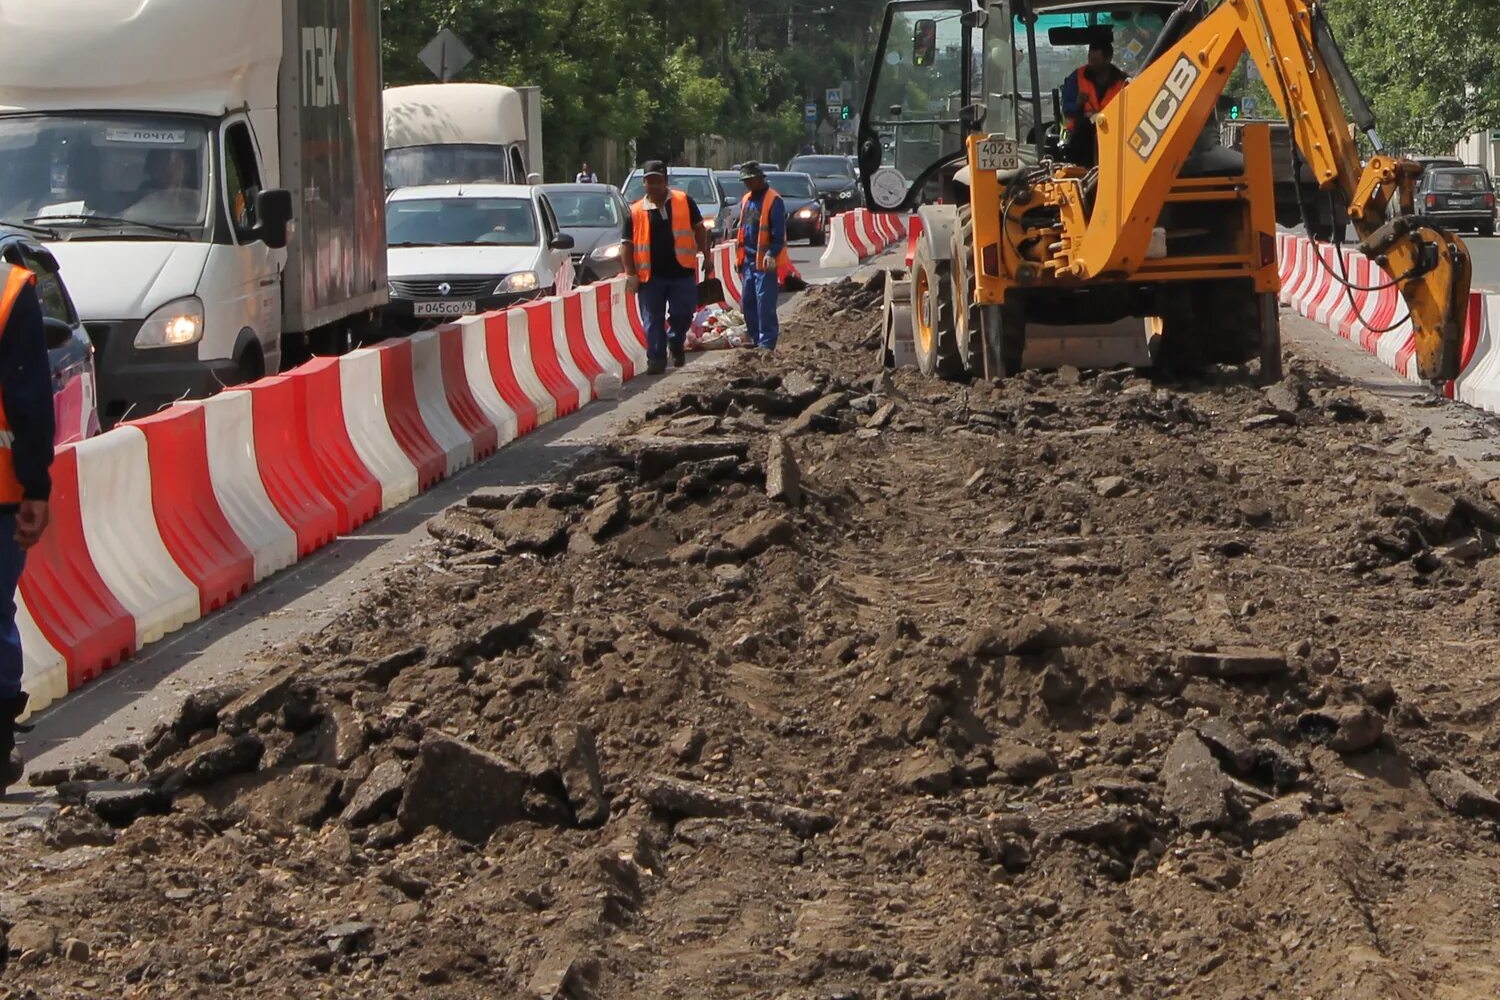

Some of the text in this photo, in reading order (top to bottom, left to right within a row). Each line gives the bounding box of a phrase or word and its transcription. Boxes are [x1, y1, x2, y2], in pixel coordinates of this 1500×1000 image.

[302, 26, 340, 107] ПЭК
[1138, 57, 1197, 158] JCB
[133, 131, 175, 140] ПОЧТА
[982, 142, 1012, 155] 4023
[1003, 158, 1015, 167] 69
